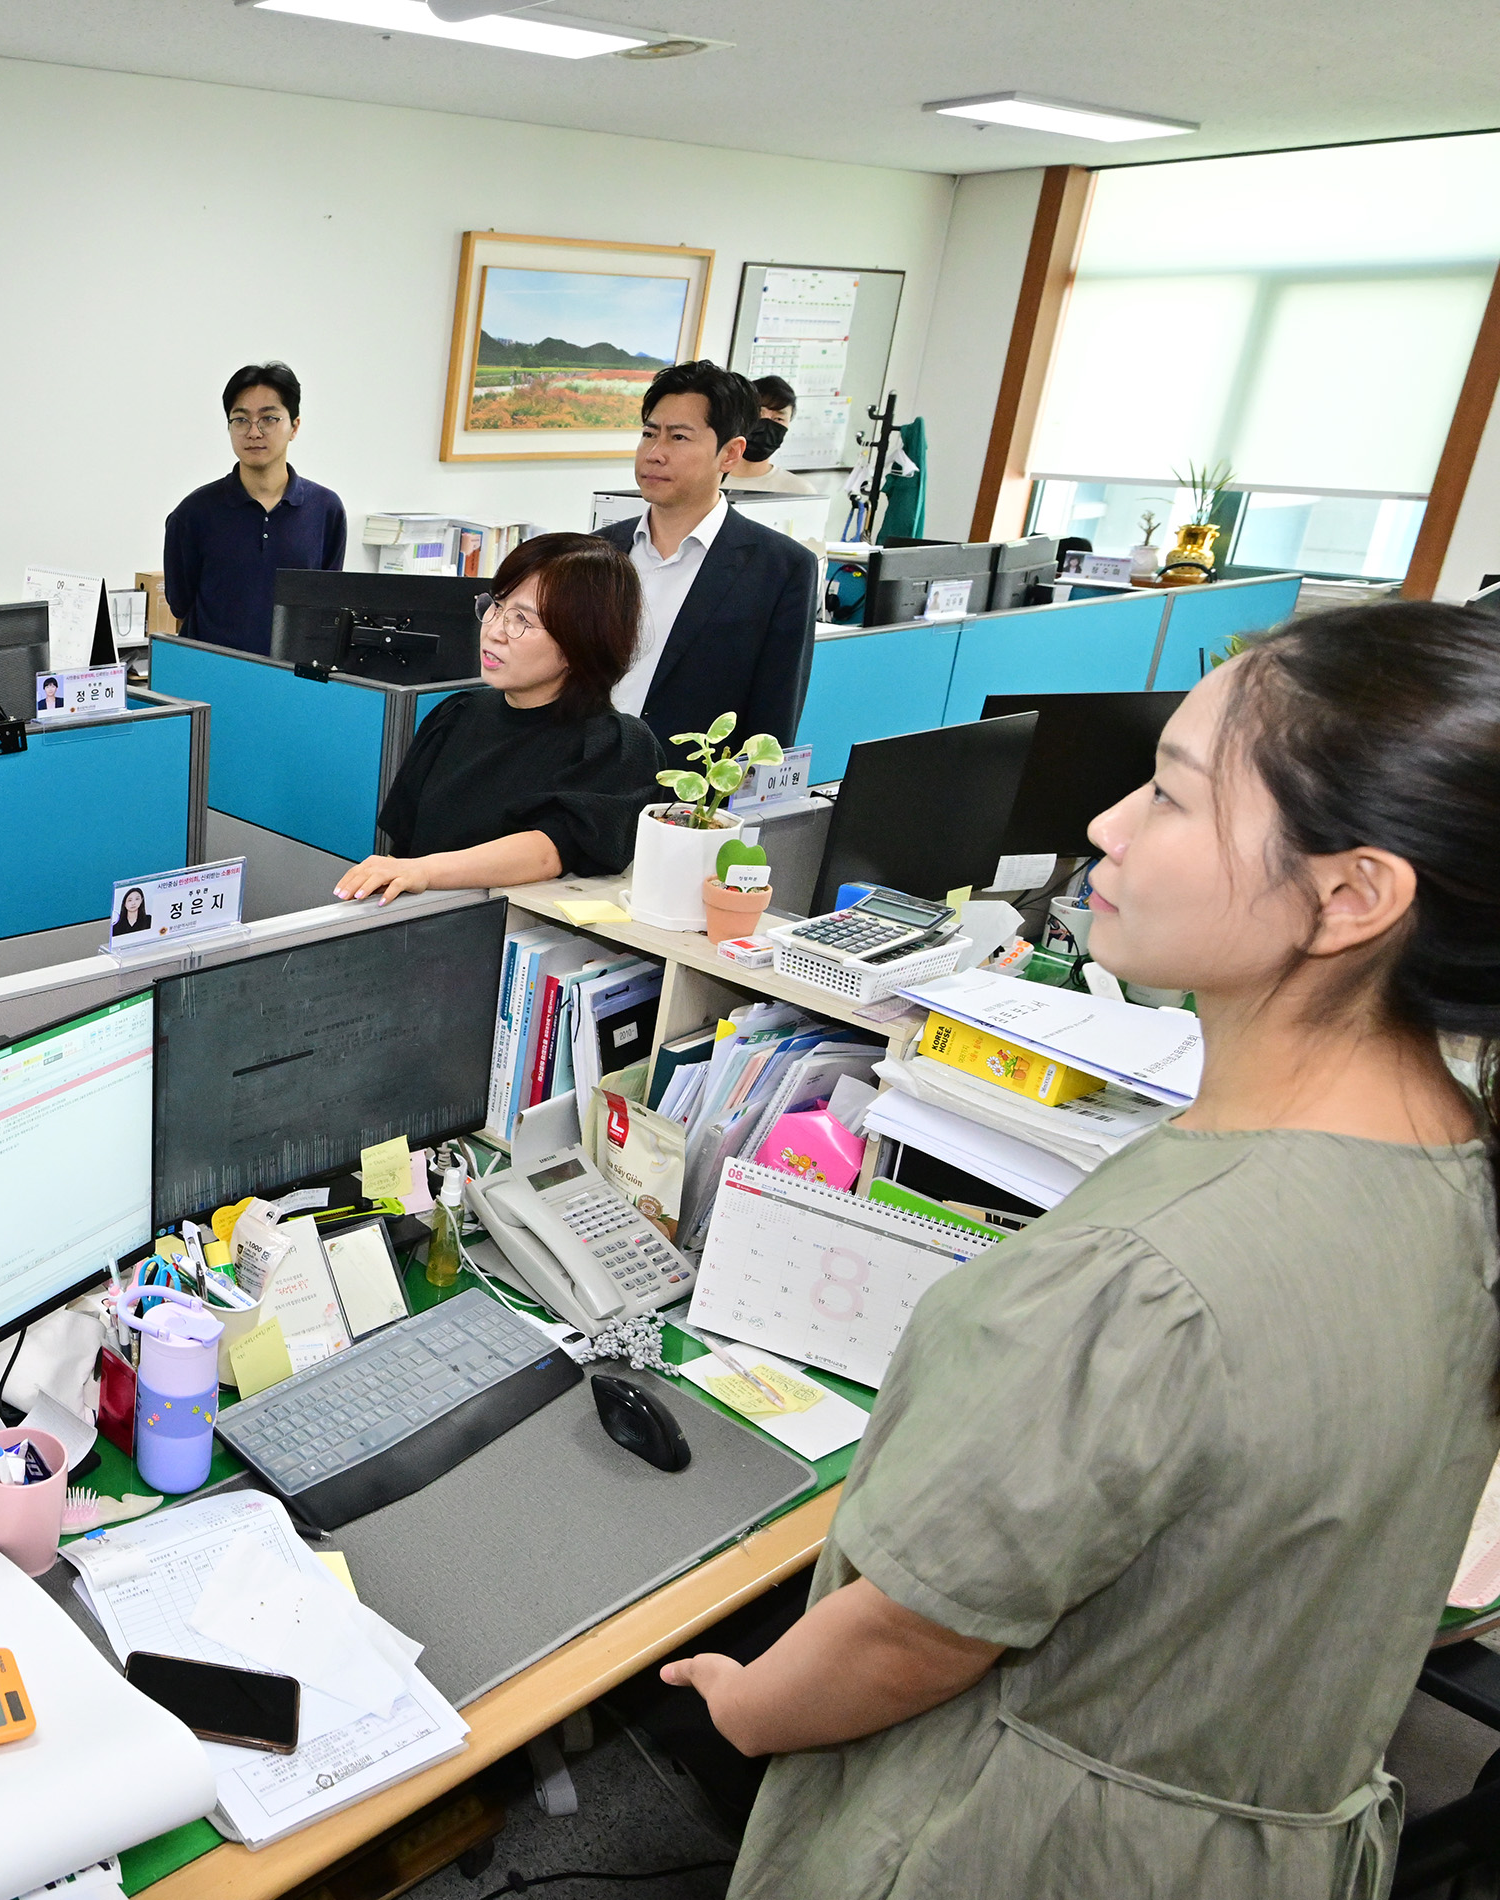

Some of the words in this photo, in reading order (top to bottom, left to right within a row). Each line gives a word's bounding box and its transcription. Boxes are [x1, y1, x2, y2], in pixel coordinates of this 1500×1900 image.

[56, 580, 65, 590] 09
[76, 687, 114, 703] 정은하
[767, 772, 800, 789] 이시원
[157, 880, 178, 890] 시민중심
[169, 893, 224, 920] 정은지
[932, 1026, 946, 1051] KOREA
[539, 1154, 557, 1164] SAMSUNG
[728, 1168, 743, 1180] 08
[781, 1285, 788, 1293] 18
[699, 1300, 707, 1308] 30
[900, 1299, 909, 1307] 14
[855, 1311, 863, 1319] 20
